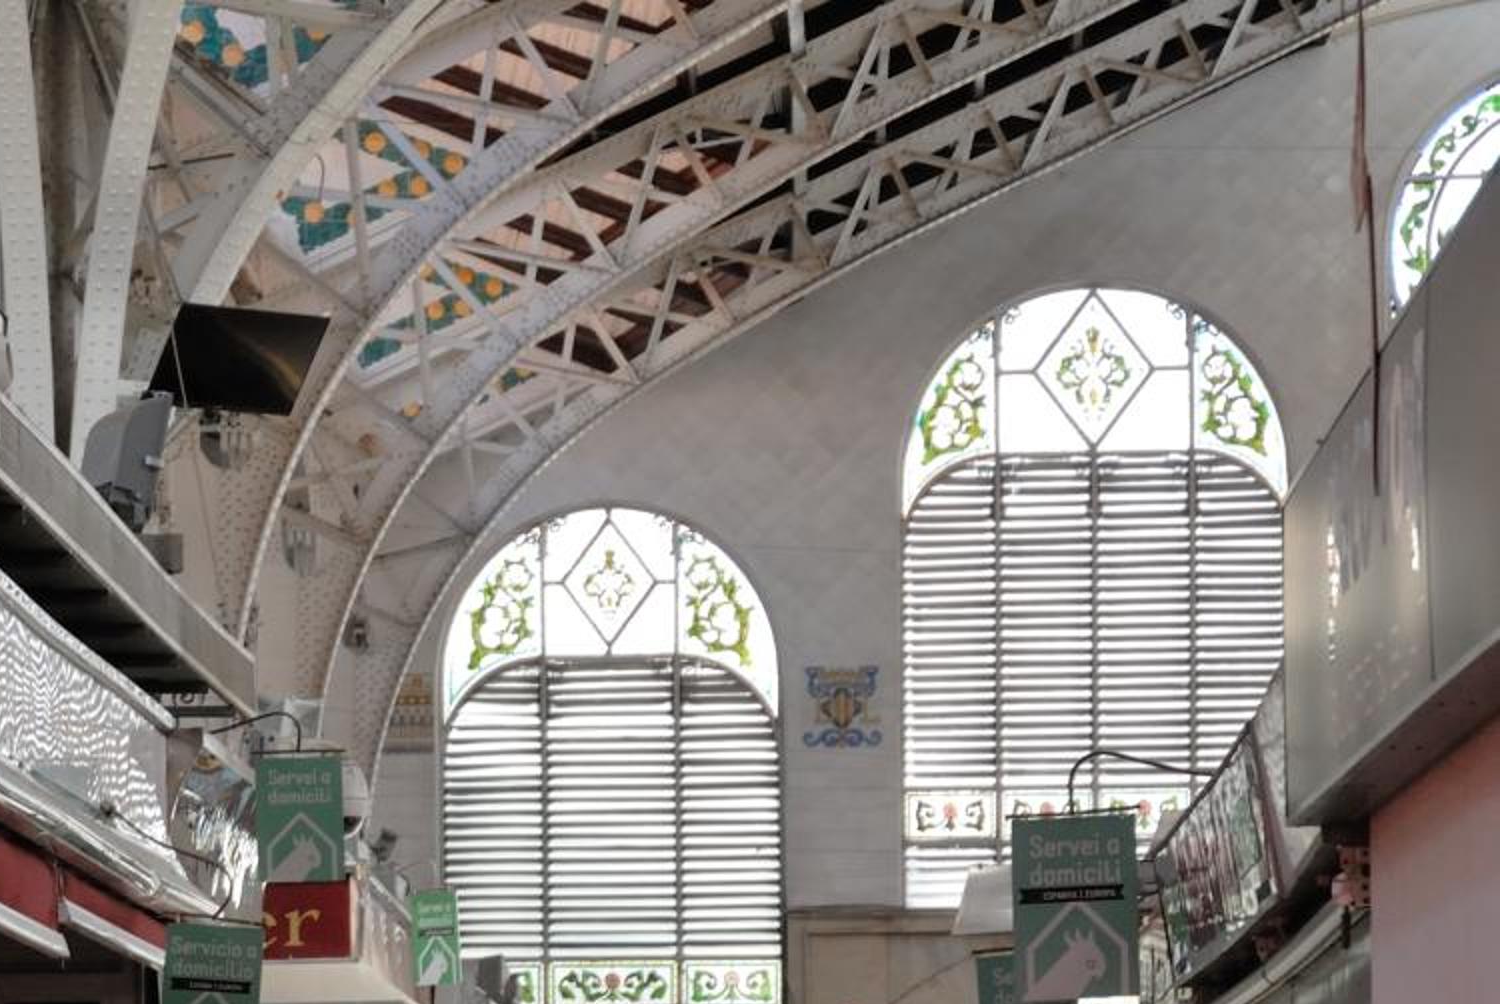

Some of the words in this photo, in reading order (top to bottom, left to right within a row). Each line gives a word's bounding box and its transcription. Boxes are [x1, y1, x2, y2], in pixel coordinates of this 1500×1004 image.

[1029, 832, 1099, 859] Servei
[1106, 837, 1121, 857] a
[1029, 860, 1122, 886] domicili
[170, 936, 243, 958] Servicio
[246, 945, 258, 959] a
[171, 960, 255, 980] domicilio
